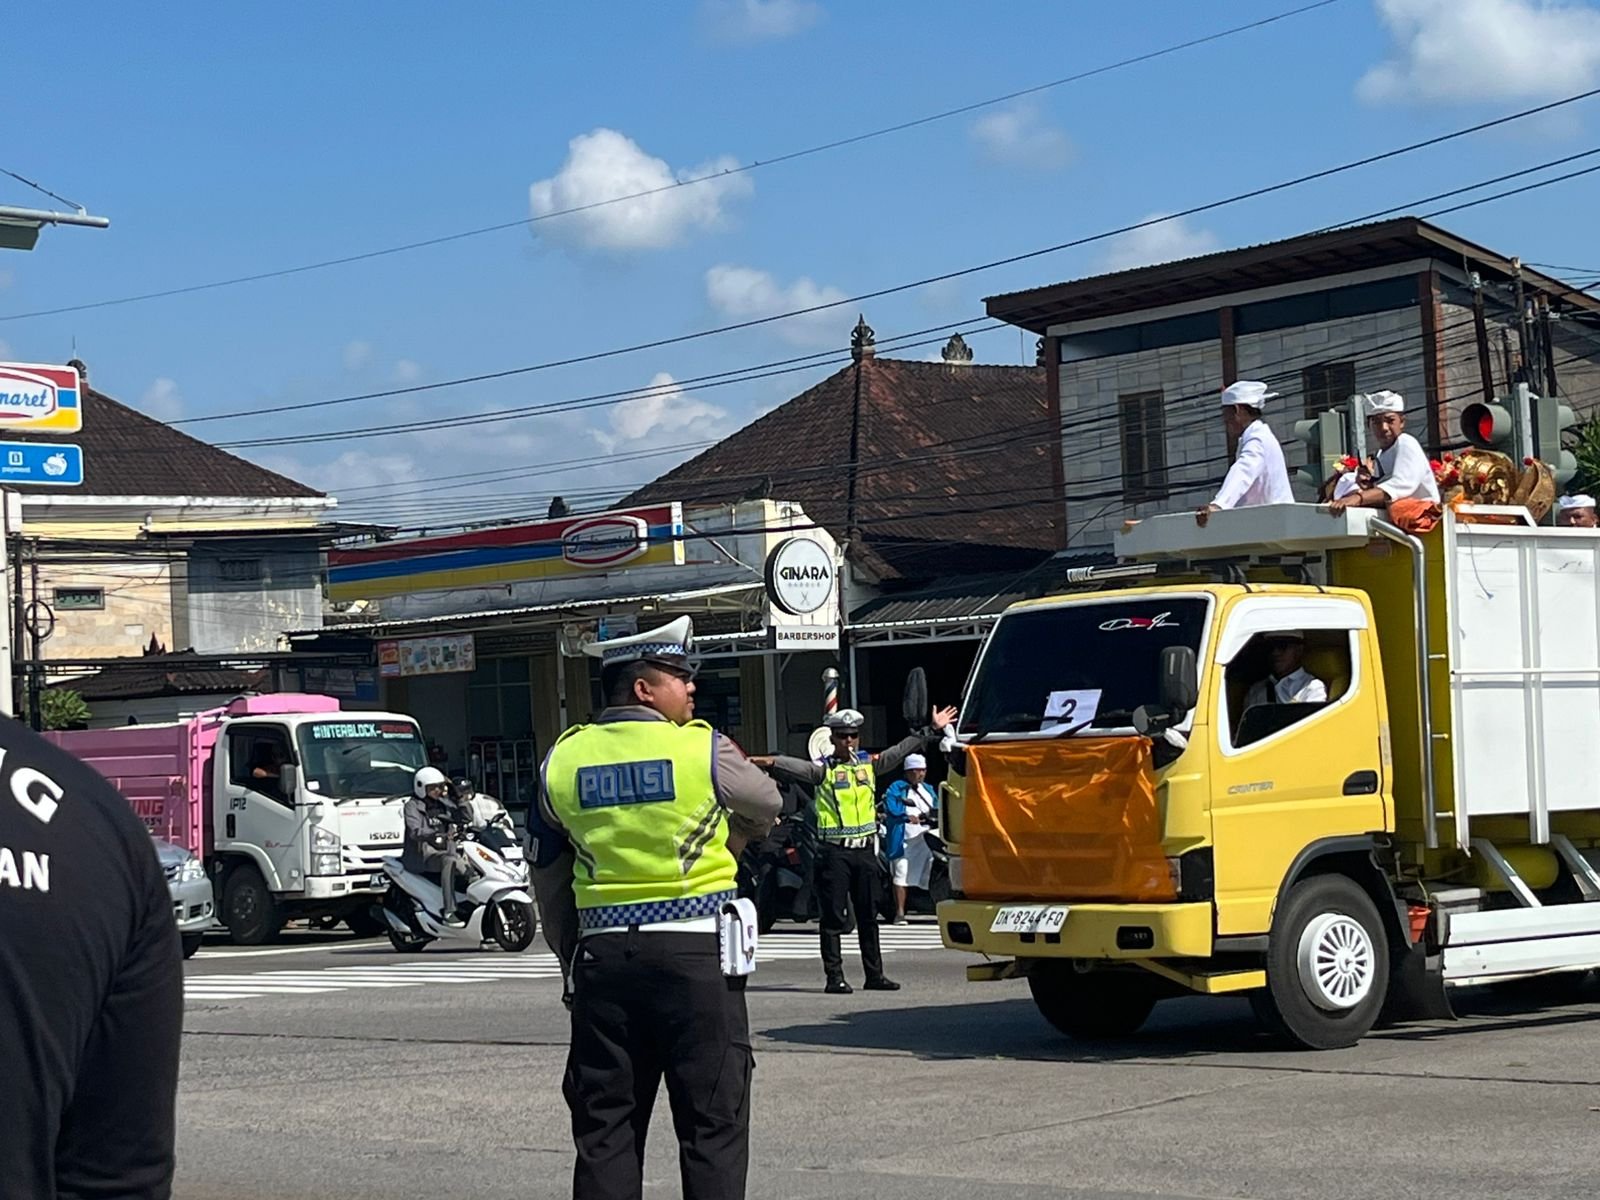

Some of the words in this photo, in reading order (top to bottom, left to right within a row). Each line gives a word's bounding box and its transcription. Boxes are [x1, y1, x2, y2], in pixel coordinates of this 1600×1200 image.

[780, 565, 829, 580] GINARA
[778, 632, 836, 641] BARBERSHOP
[1057, 699, 1077, 723] 2
[0, 748, 64, 824] G
[581, 764, 673, 800] POLISI
[369, 832, 400, 840] ISUZU
[0, 848, 49, 892] AN
